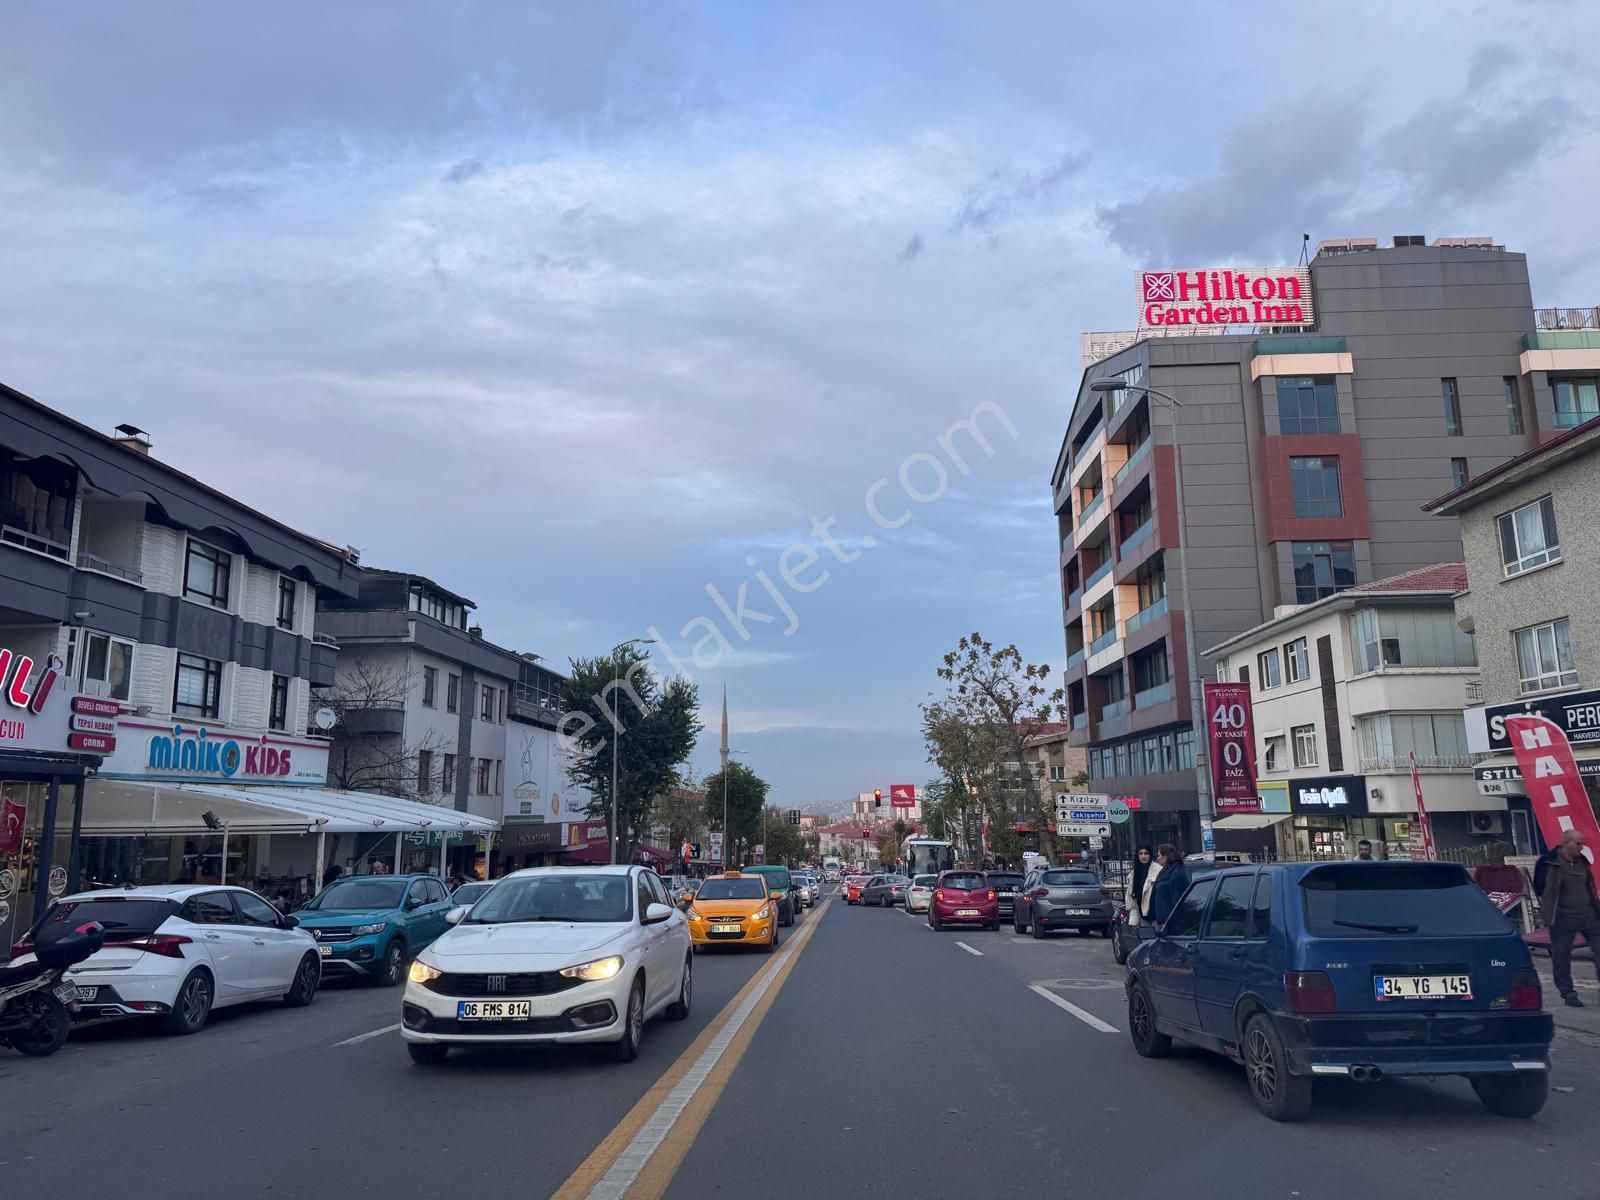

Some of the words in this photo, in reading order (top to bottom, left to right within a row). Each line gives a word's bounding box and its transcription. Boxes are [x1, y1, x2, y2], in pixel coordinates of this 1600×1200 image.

[1176, 271, 1302, 301] Hilton
[1145, 302, 1249, 326] Garden
[1252, 301, 1305, 323] Inn
[77, 718, 94, 729] TEPSİ
[1212, 704, 1246, 729] 40
[1566, 705, 1600, 729] PER
[1223, 730, 1247, 738] TAKSİT
[83, 737, 105, 749] ÇORBA
[1223, 742, 1242, 766] 0
[1225, 767, 1245, 777] FAİZ
[1482, 766, 1522, 780] STİL
[1491, 959, 1506, 968] Uno
[487, 975, 508, 992] FIAT
[1384, 978, 1402, 994] 34
[1412, 978, 1430, 994] YG
[1441, 977, 1468, 994] 145
[464, 1003, 478, 1016] 06
[482, 1003, 503, 1016] FMS
[508, 1003, 528, 1016] 814
